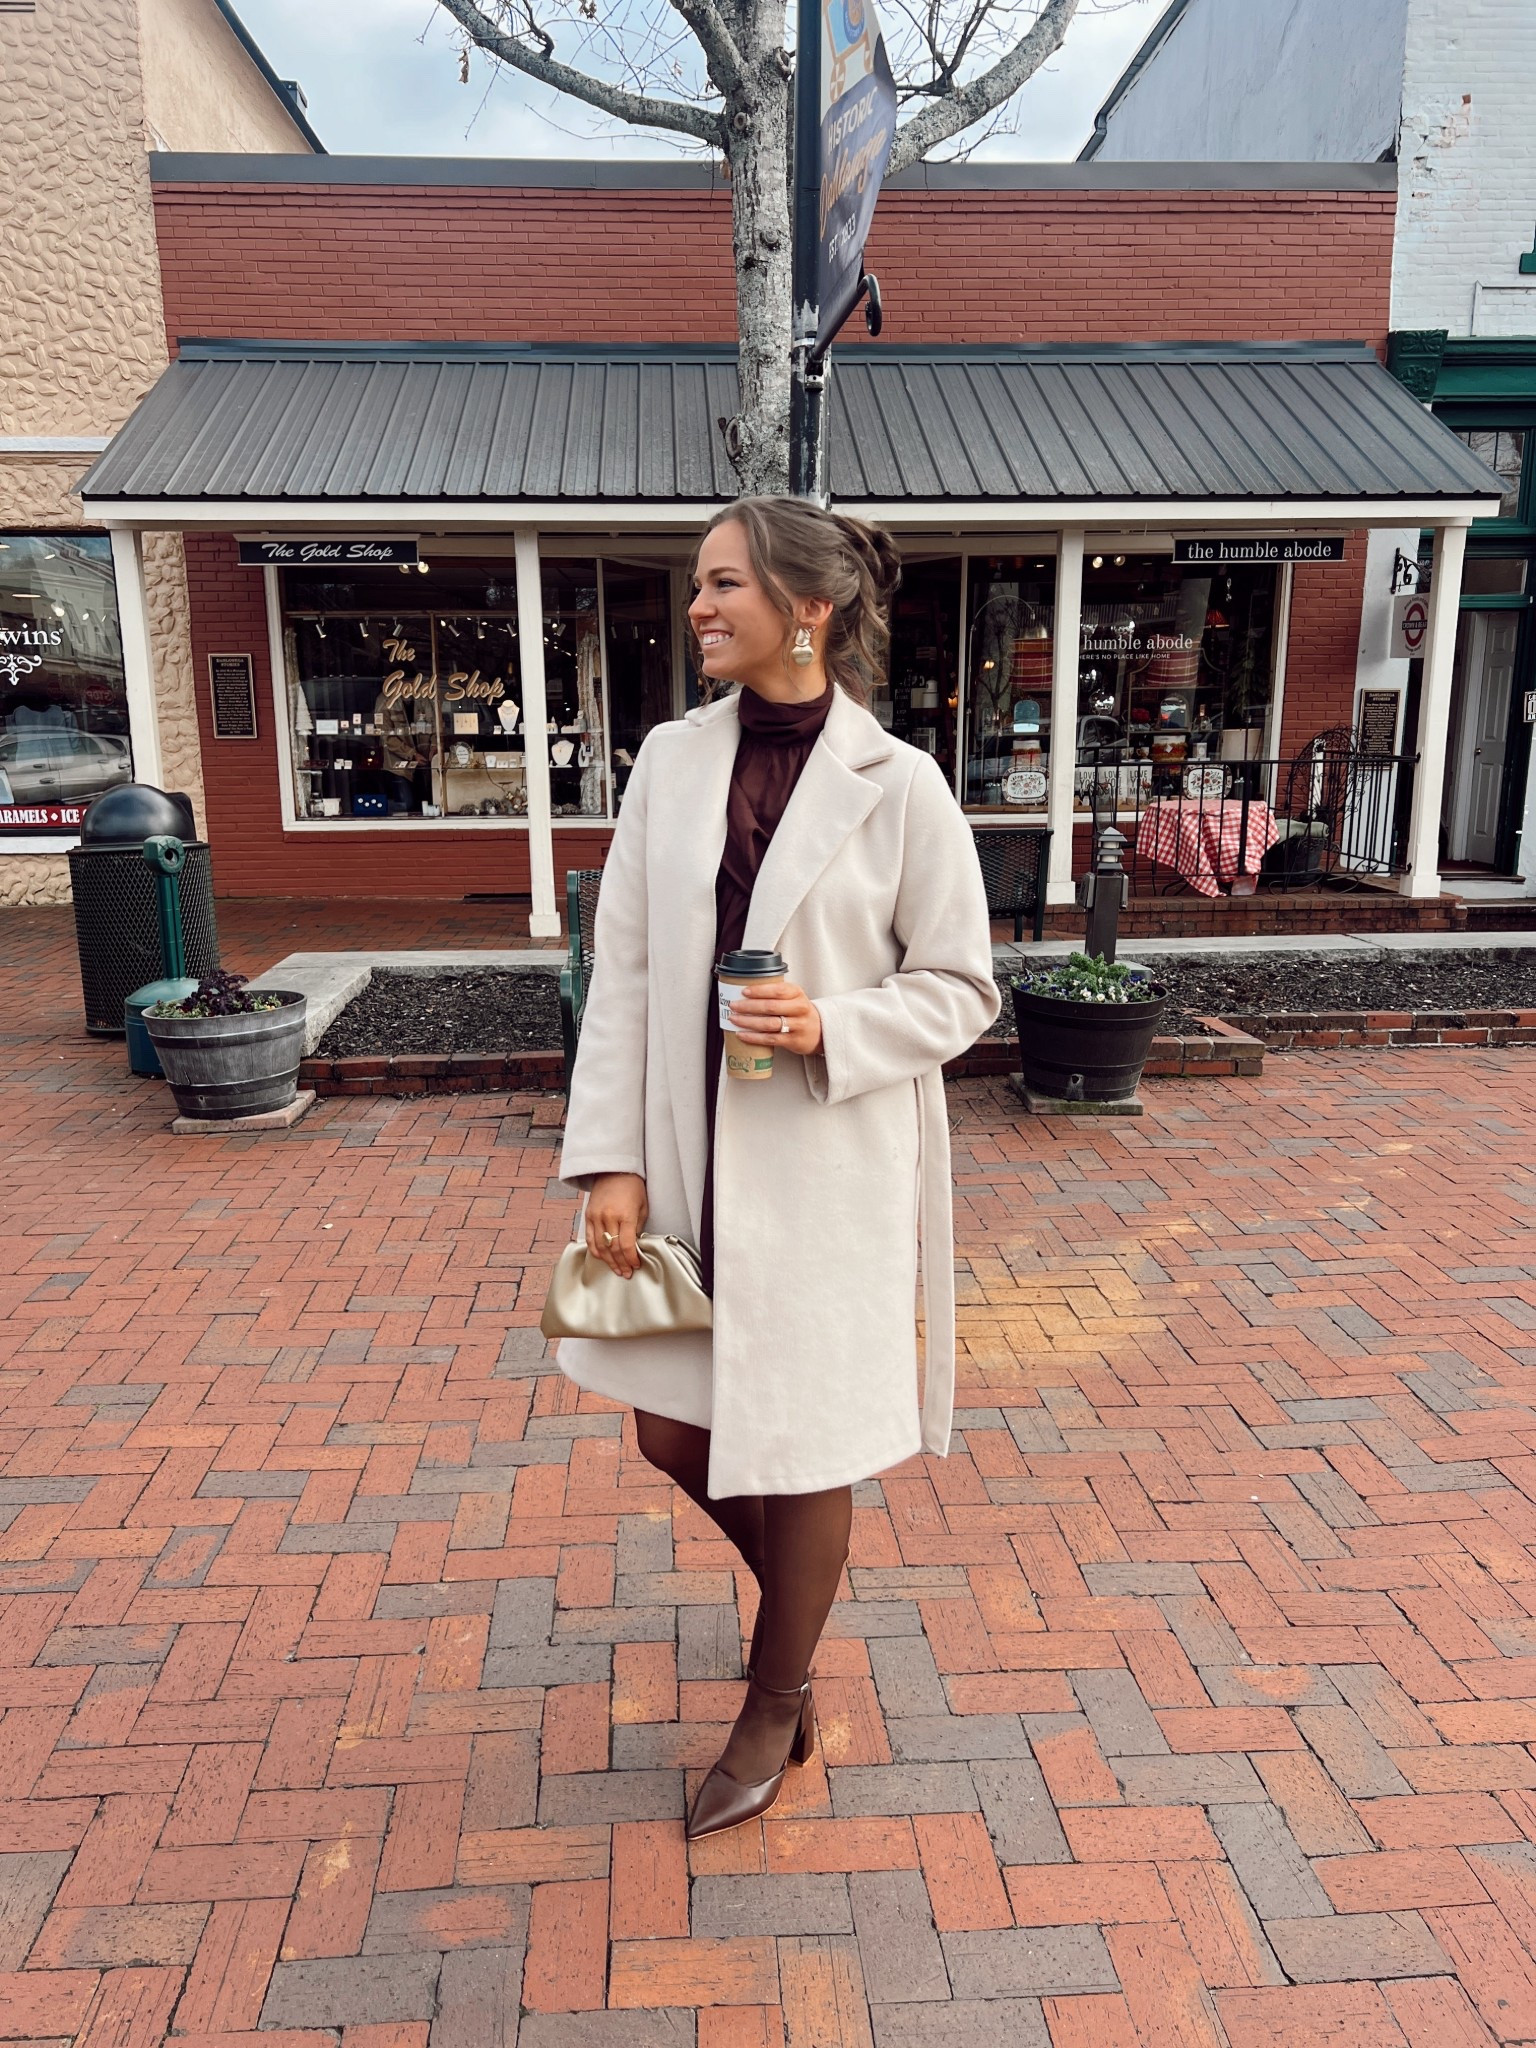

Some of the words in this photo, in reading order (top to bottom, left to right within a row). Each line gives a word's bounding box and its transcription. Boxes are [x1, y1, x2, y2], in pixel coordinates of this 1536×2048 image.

[828, 86, 878, 154] HISTORIC
[261, 543, 295, 558] The
[300, 543, 341, 562] Gold
[346, 543, 393, 561] Shop
[1187, 543, 1214, 559] the
[1219, 542, 1279, 559] humble
[1284, 541, 1332, 558] abode
[0, 623, 61, 645] wins
[1083, 634, 1142, 650] humble
[1146, 633, 1193, 650] abode
[382, 639, 416, 662] The
[382, 670, 438, 709] Gold
[444, 670, 506, 706] Shop
[60, 808, 81, 824] ICE
